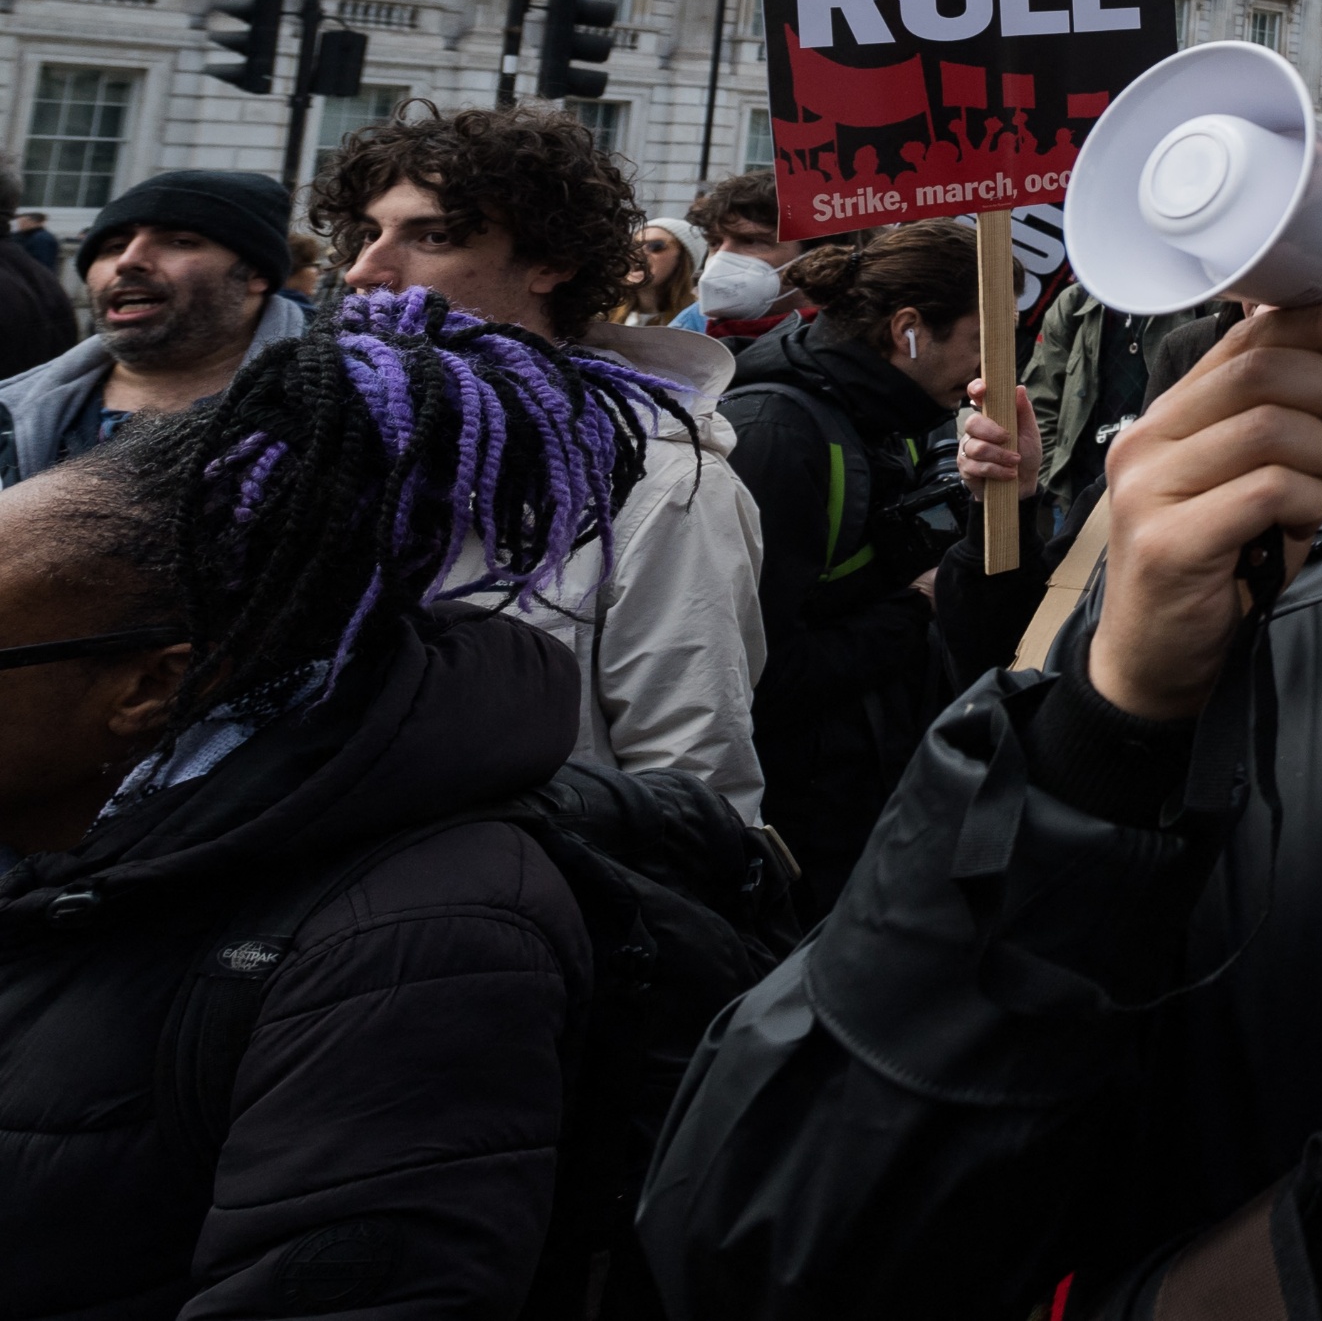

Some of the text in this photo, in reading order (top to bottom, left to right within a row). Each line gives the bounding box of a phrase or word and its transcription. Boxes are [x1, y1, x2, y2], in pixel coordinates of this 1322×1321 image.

[812, 186, 908, 222] Strike,
[915, 172, 1018, 207] march,
[222, 948, 279, 963] EASTPAK
